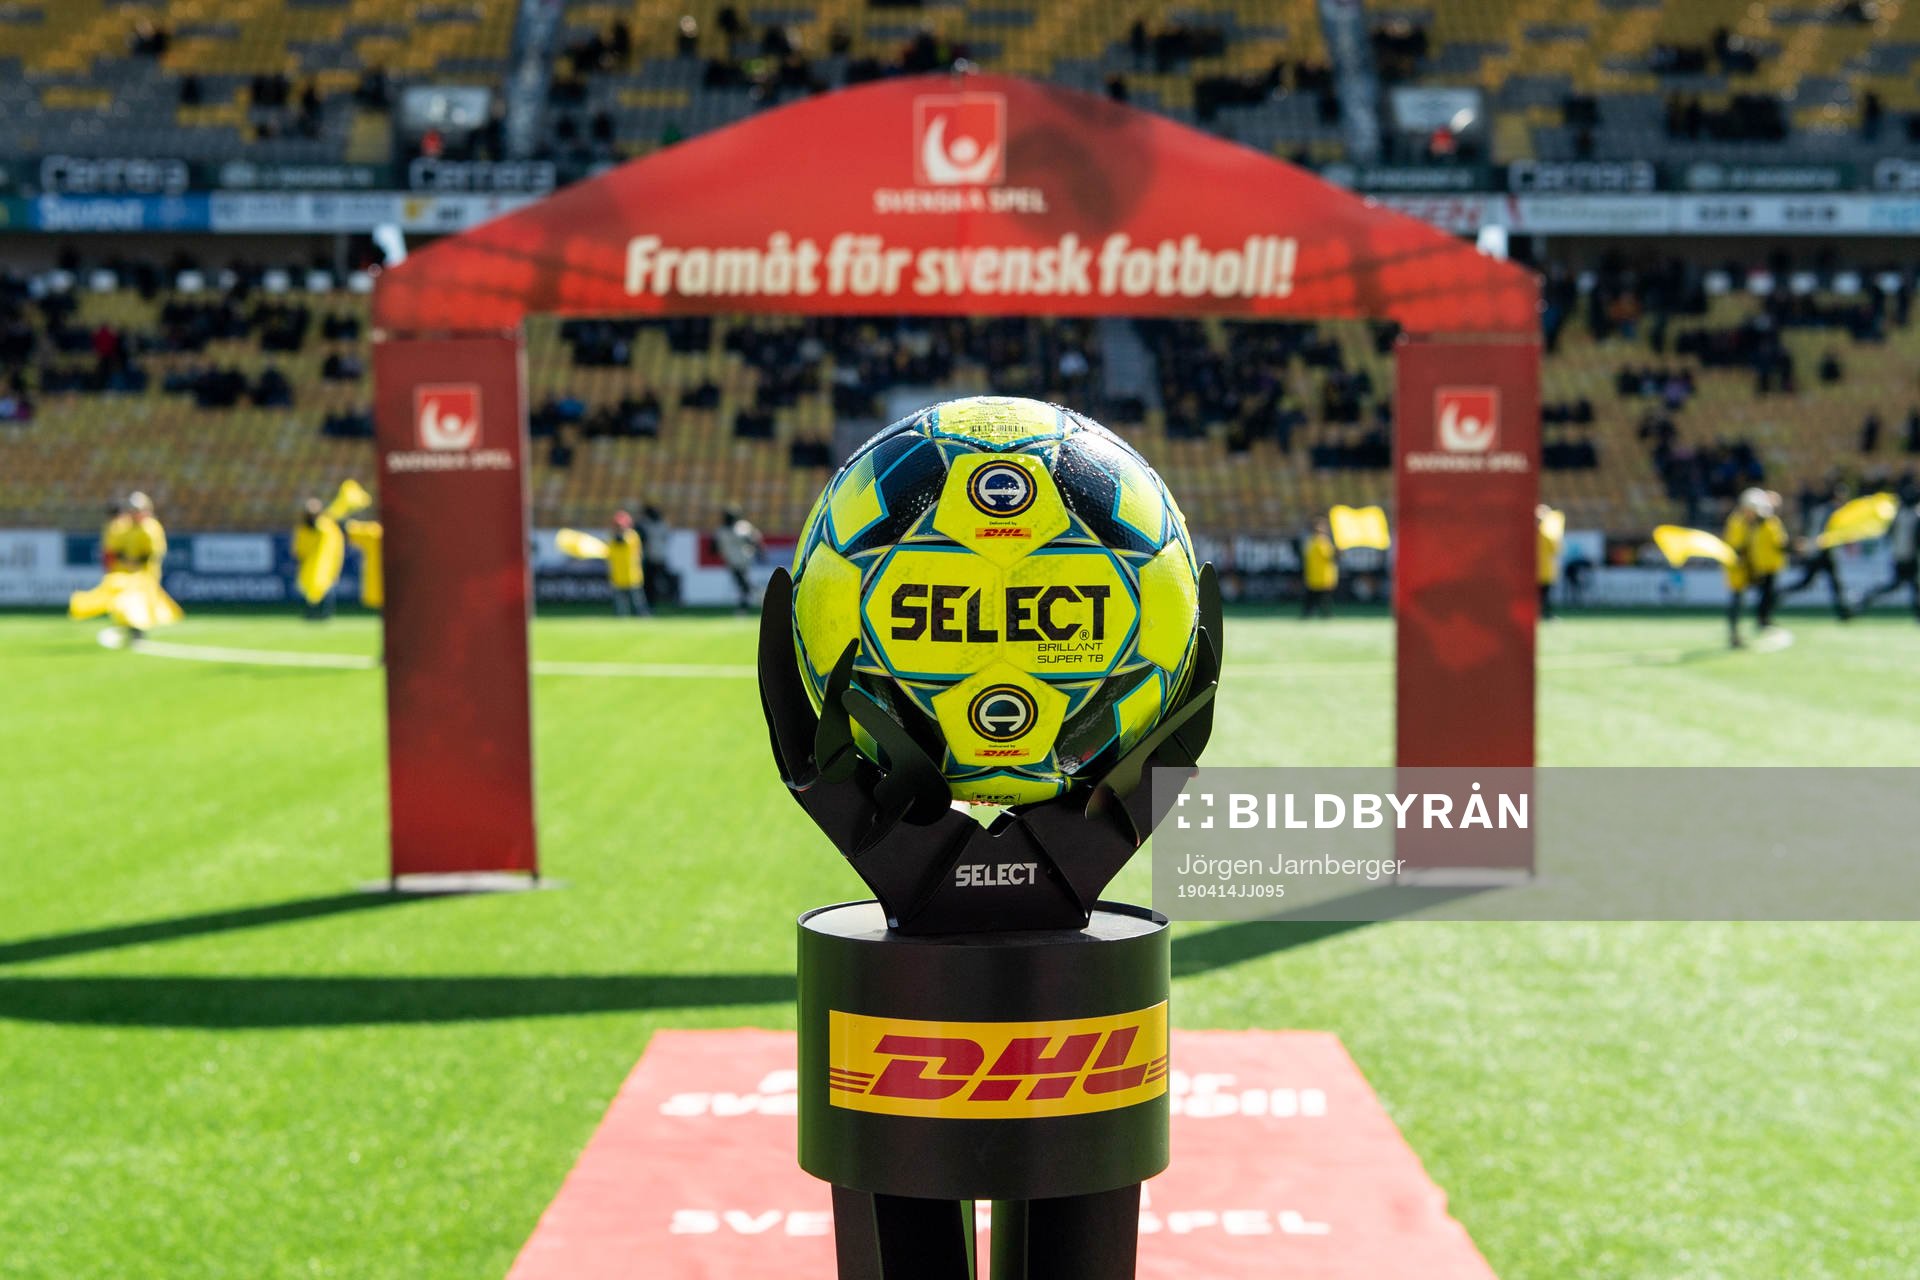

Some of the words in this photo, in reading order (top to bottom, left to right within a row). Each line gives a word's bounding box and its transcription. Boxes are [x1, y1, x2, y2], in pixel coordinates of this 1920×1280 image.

[988, 187, 1047, 214] SPEL
[625, 231, 820, 296] Framåt
[827, 233, 912, 296] för
[912, 232, 1092, 296] svensk
[1099, 232, 1297, 298] fotboll!
[983, 528, 1024, 537] DHL
[891, 583, 1111, 643] SELECT
[1037, 642, 1104, 653] BRILLANT
[1037, 655, 1083, 664] SUPER
[1088, 654, 1104, 663] TB
[983, 749, 1022, 757] DHL
[955, 862, 1038, 887] SELECT
[869, 1025, 1149, 1102] DHL
